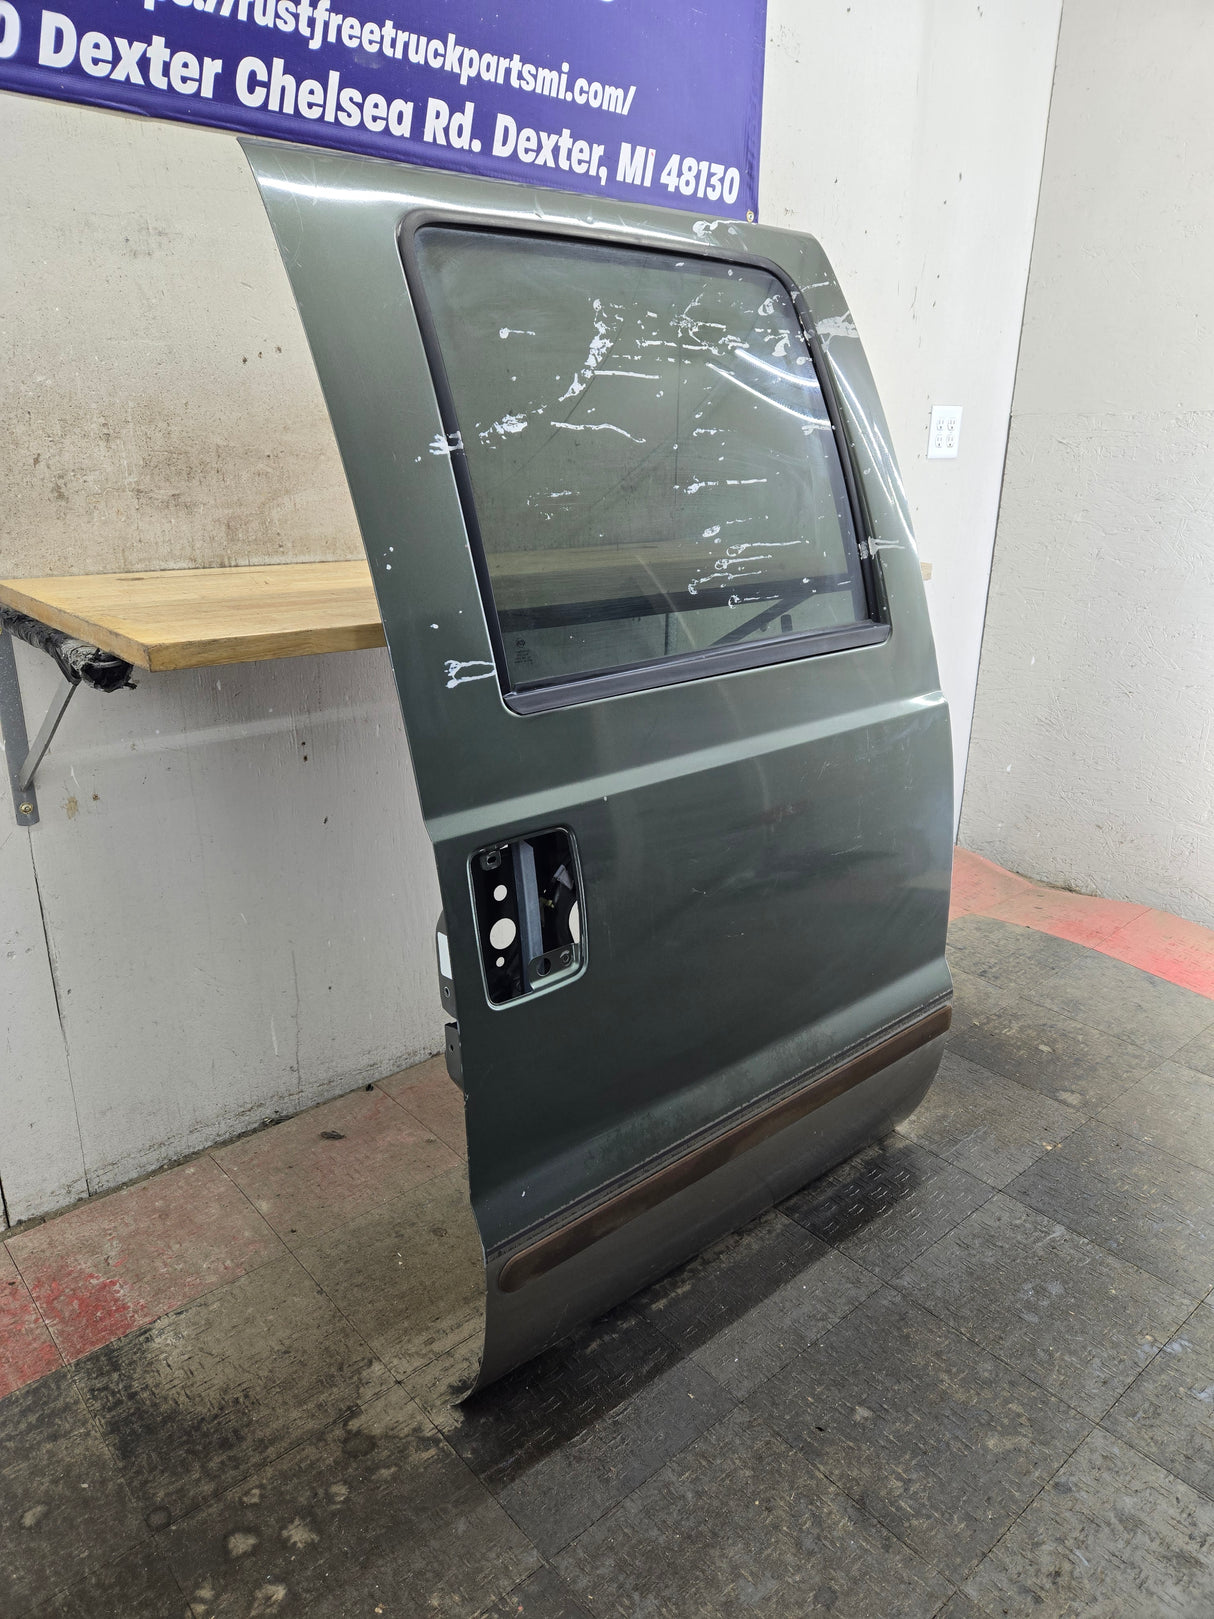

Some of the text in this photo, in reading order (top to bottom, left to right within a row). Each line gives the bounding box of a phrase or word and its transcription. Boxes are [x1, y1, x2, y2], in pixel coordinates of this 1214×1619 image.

[38, 9, 222, 99] Dexter
[235, 56, 413, 138] Chelsea
[423, 97, 482, 153] Rd.
[492, 112, 607, 186] Dexter,
[616, 142, 656, 188] MI
[660, 153, 741, 205] 48130
